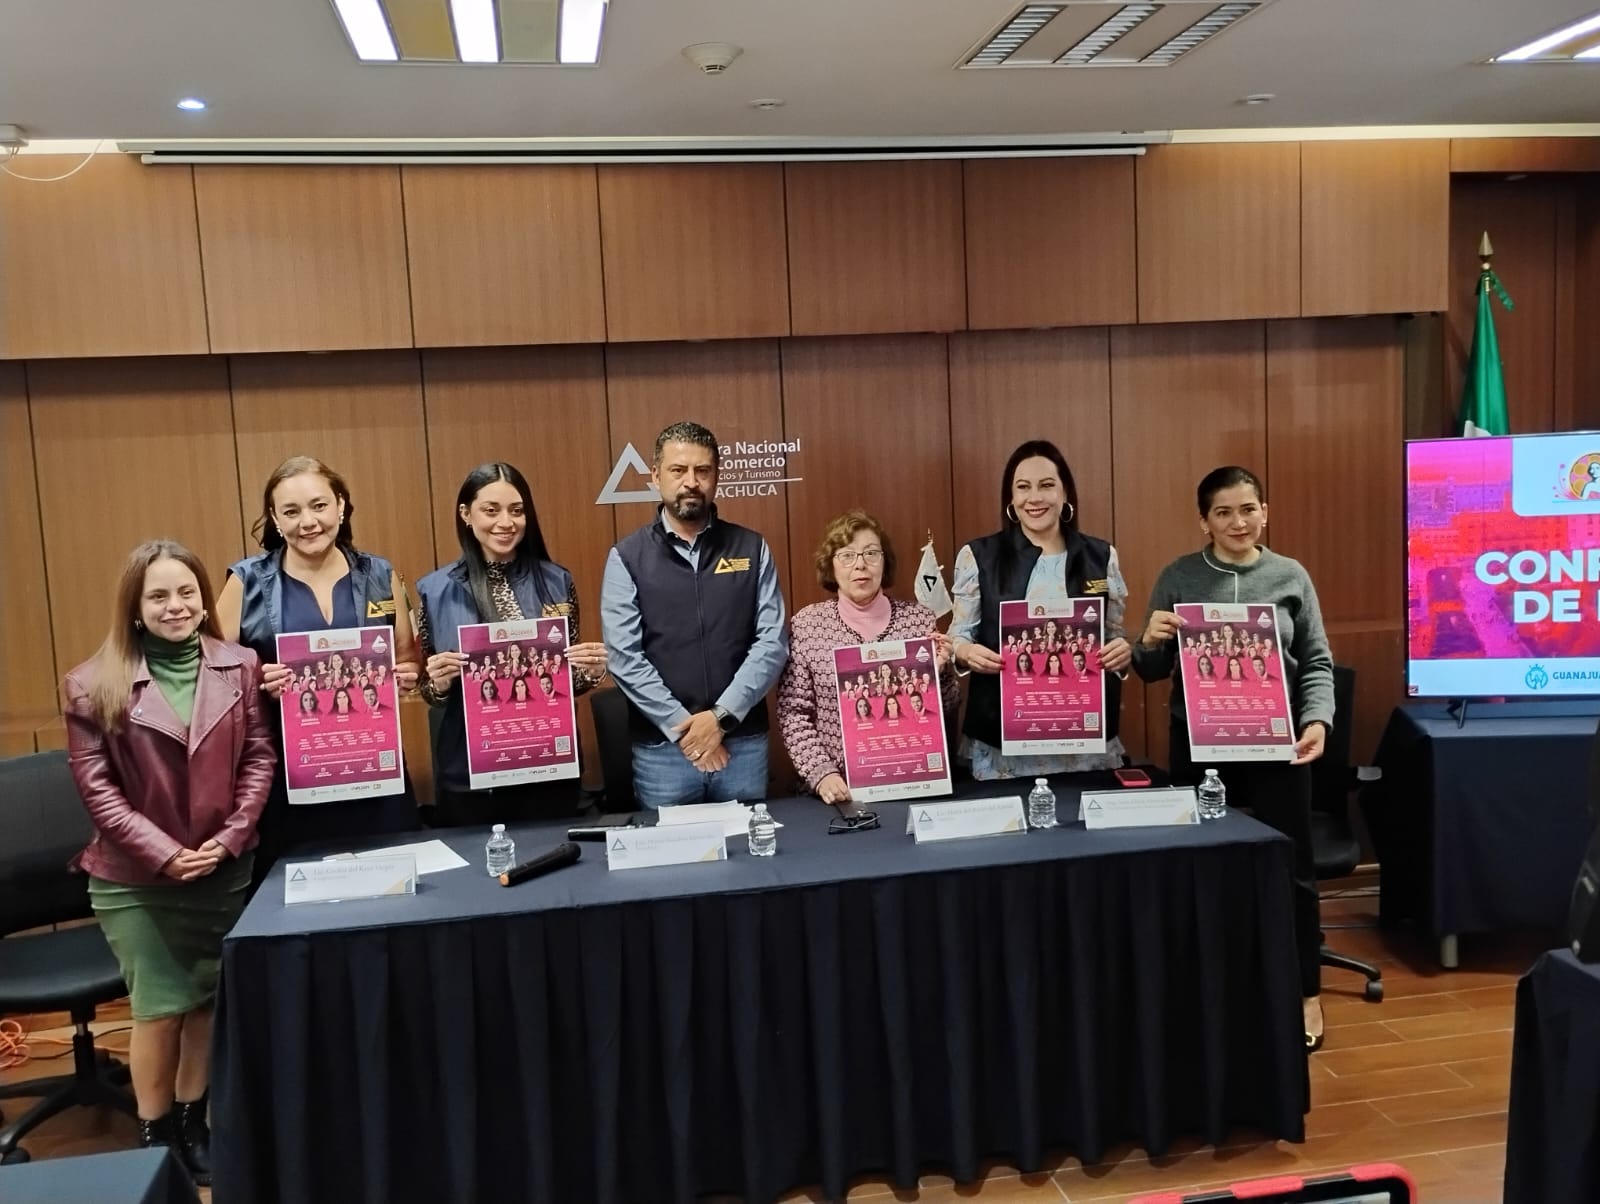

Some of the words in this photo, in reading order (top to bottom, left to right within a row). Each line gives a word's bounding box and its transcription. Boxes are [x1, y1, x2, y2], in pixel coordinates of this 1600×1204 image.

[718, 445, 731, 455] ra
[735, 438, 800, 454] Nacional
[718, 472, 736, 480] cios
[738, 472, 743, 481] y
[744, 470, 781, 478] Turismo
[714, 484, 778, 498] ACHUCA
[1513, 589, 1581, 623] DE
[1552, 671, 1600, 680] GUANAJU
